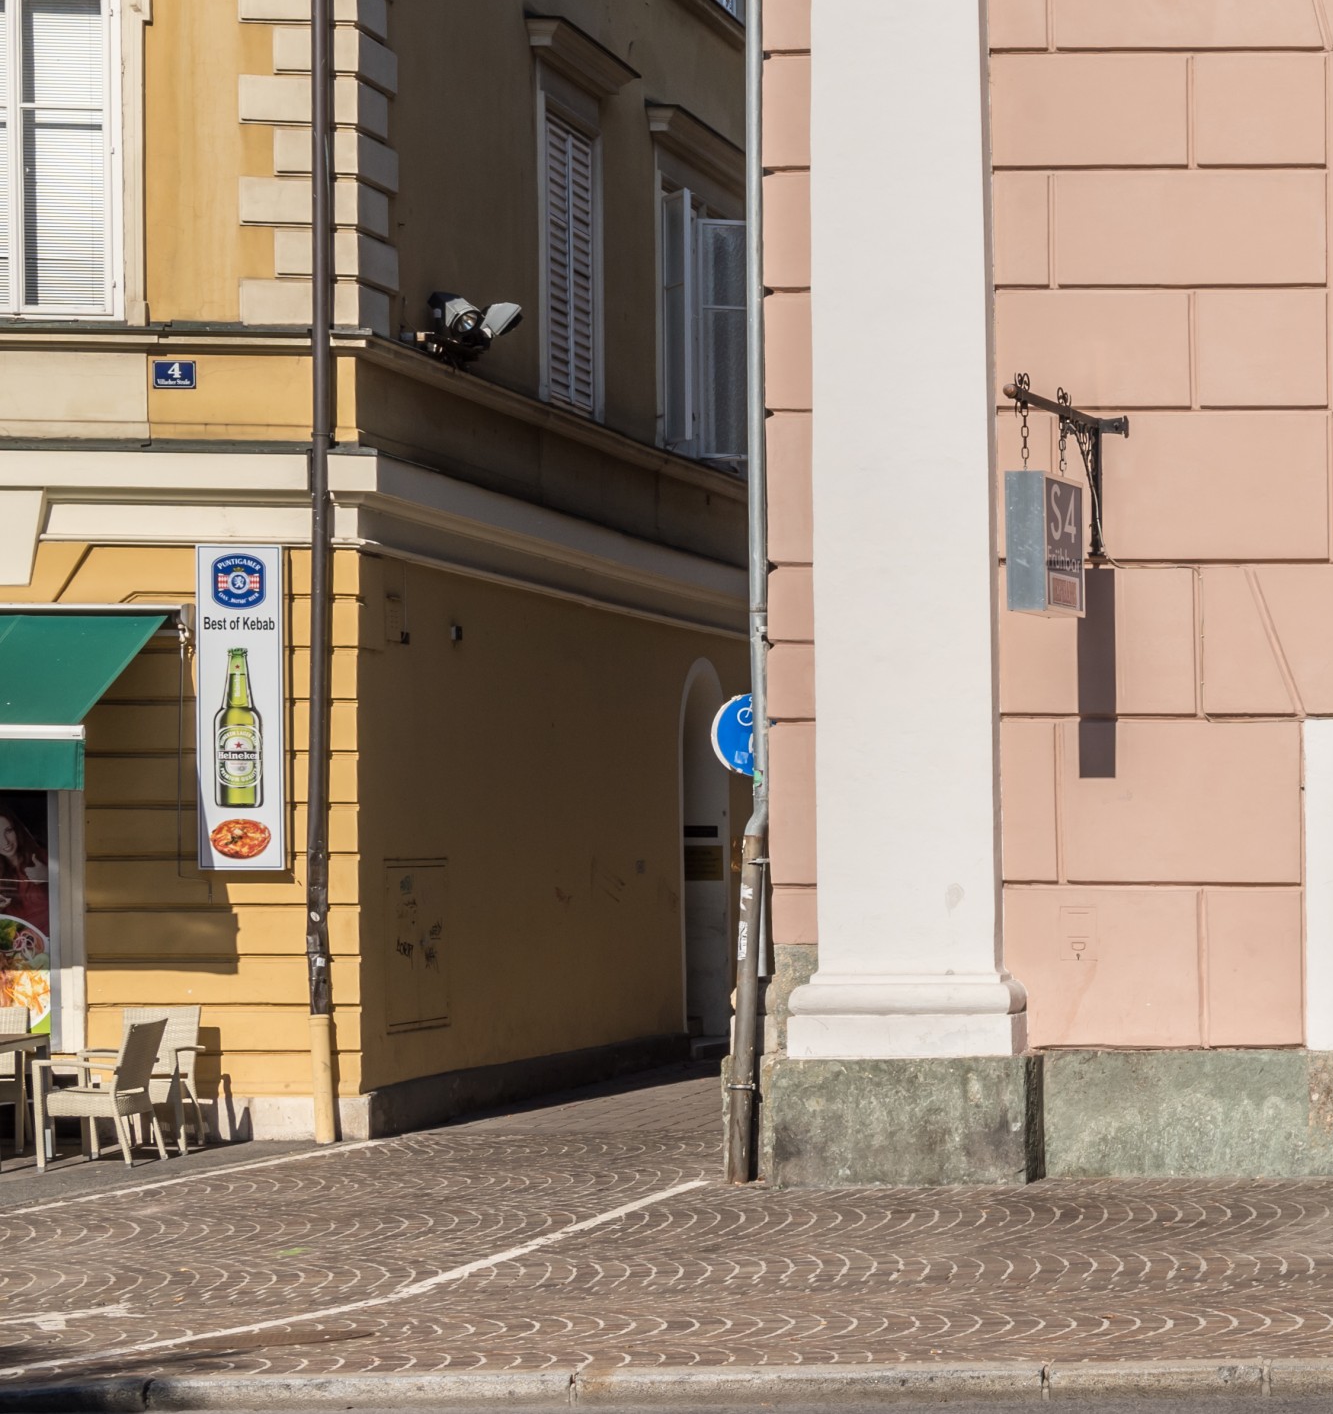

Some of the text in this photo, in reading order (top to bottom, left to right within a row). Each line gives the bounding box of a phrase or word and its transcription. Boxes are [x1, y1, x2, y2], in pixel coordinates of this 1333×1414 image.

[167, 362, 182, 379] 4
[217, 558, 261, 571] PUNTIGAMER
[203, 616, 276, 631] Best of Kebab
